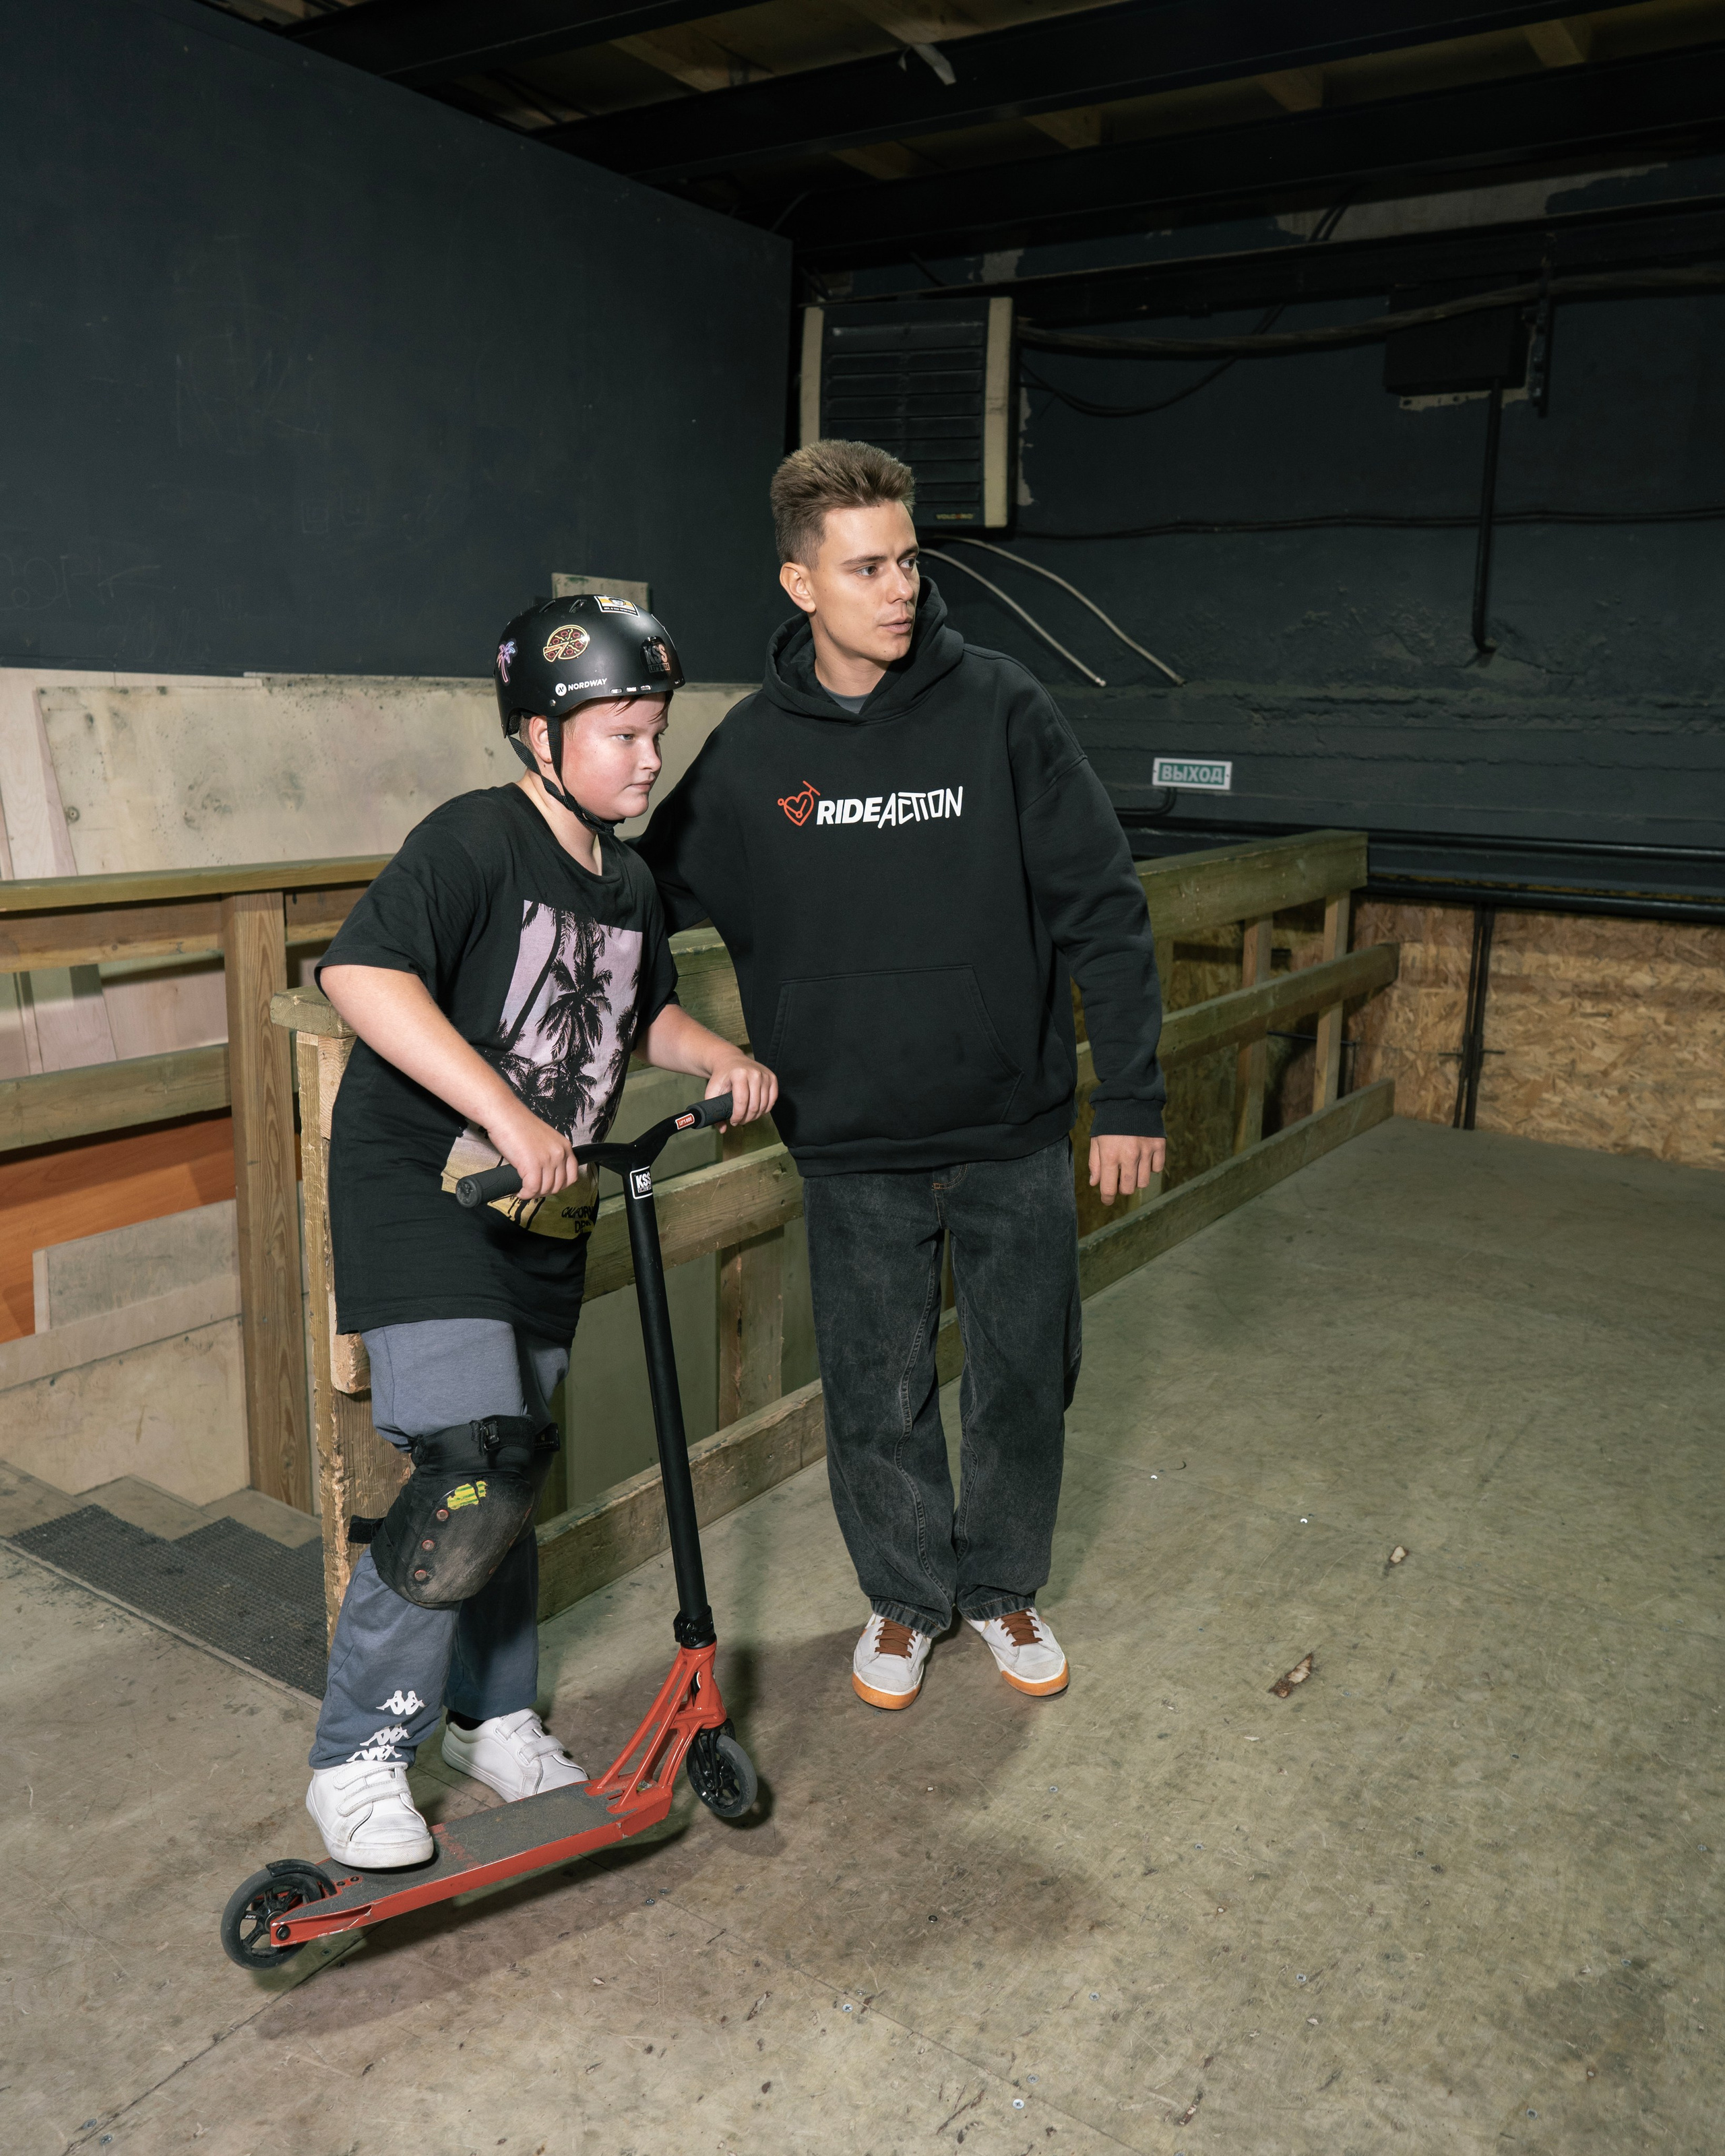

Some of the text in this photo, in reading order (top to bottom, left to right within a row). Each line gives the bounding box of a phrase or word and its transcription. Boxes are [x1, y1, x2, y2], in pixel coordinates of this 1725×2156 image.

[643, 644, 668, 665] KSS
[568, 678, 607, 691] NORDWAY
[1161, 765, 1224, 784] ВЫХОД
[635, 1172, 652, 1188] KSS
